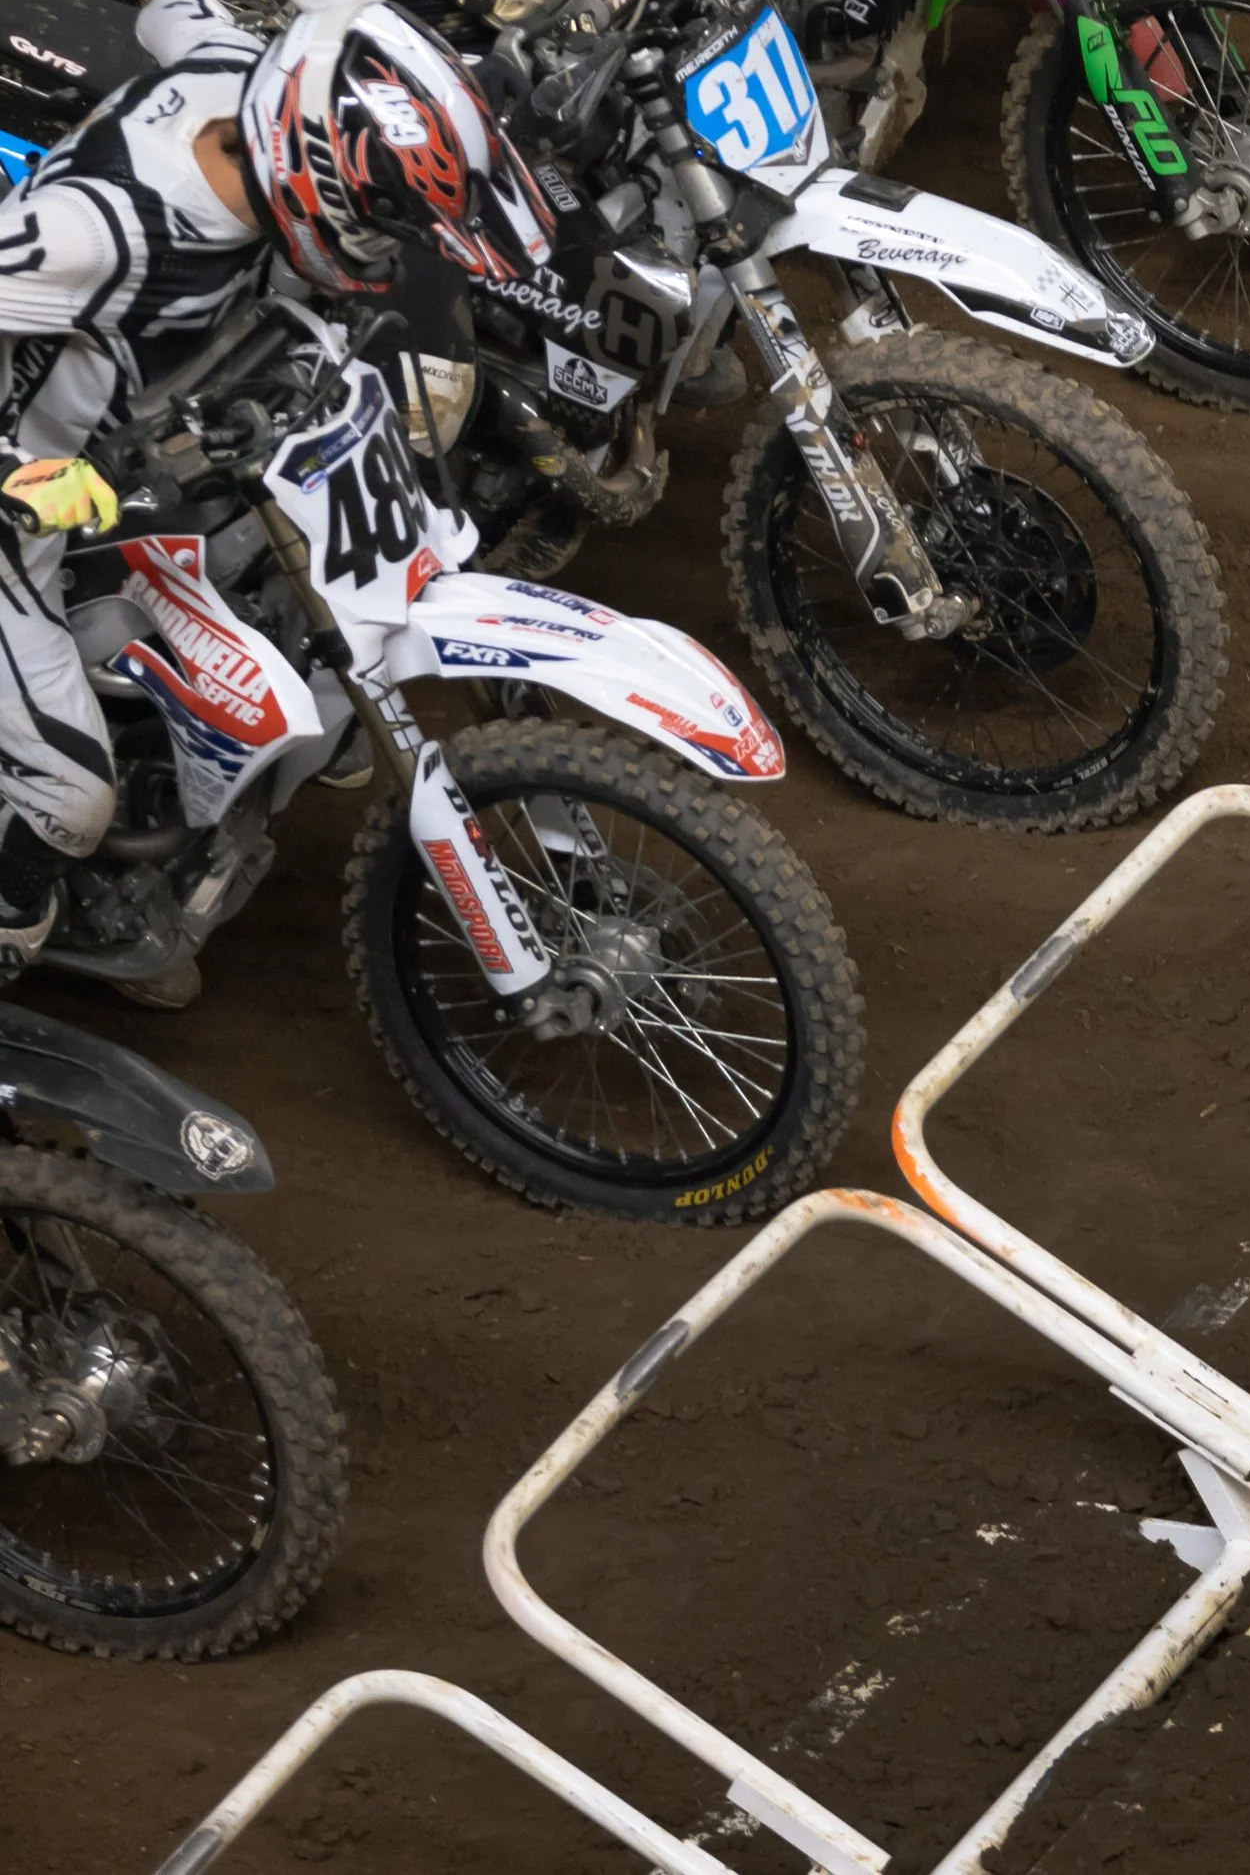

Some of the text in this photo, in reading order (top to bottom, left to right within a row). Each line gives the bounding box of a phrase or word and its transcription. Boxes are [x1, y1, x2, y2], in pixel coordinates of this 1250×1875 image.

[9, 34, 88, 76] GUTS
[674, 25, 740, 84] MEREDITH
[363, 82, 429, 148] 489
[696, 11, 812, 173] 317
[271, 129, 286, 177] BELL
[1103, 104, 1156, 191] DUNLOP
[856, 238, 969, 270] Beverage
[468, 272, 603, 334] everage
[554, 369, 608, 405] SCCMX
[324, 408, 429, 591] 489
[802, 444, 862, 523] THOR
[442, 640, 511, 666] FXR
[502, 614, 605, 641] MOTOPRO
[193, 673, 266, 729] SEPTIC
[444, 784, 545, 963] DNLOP
[674, 1149, 770, 1209] DUNLOP
